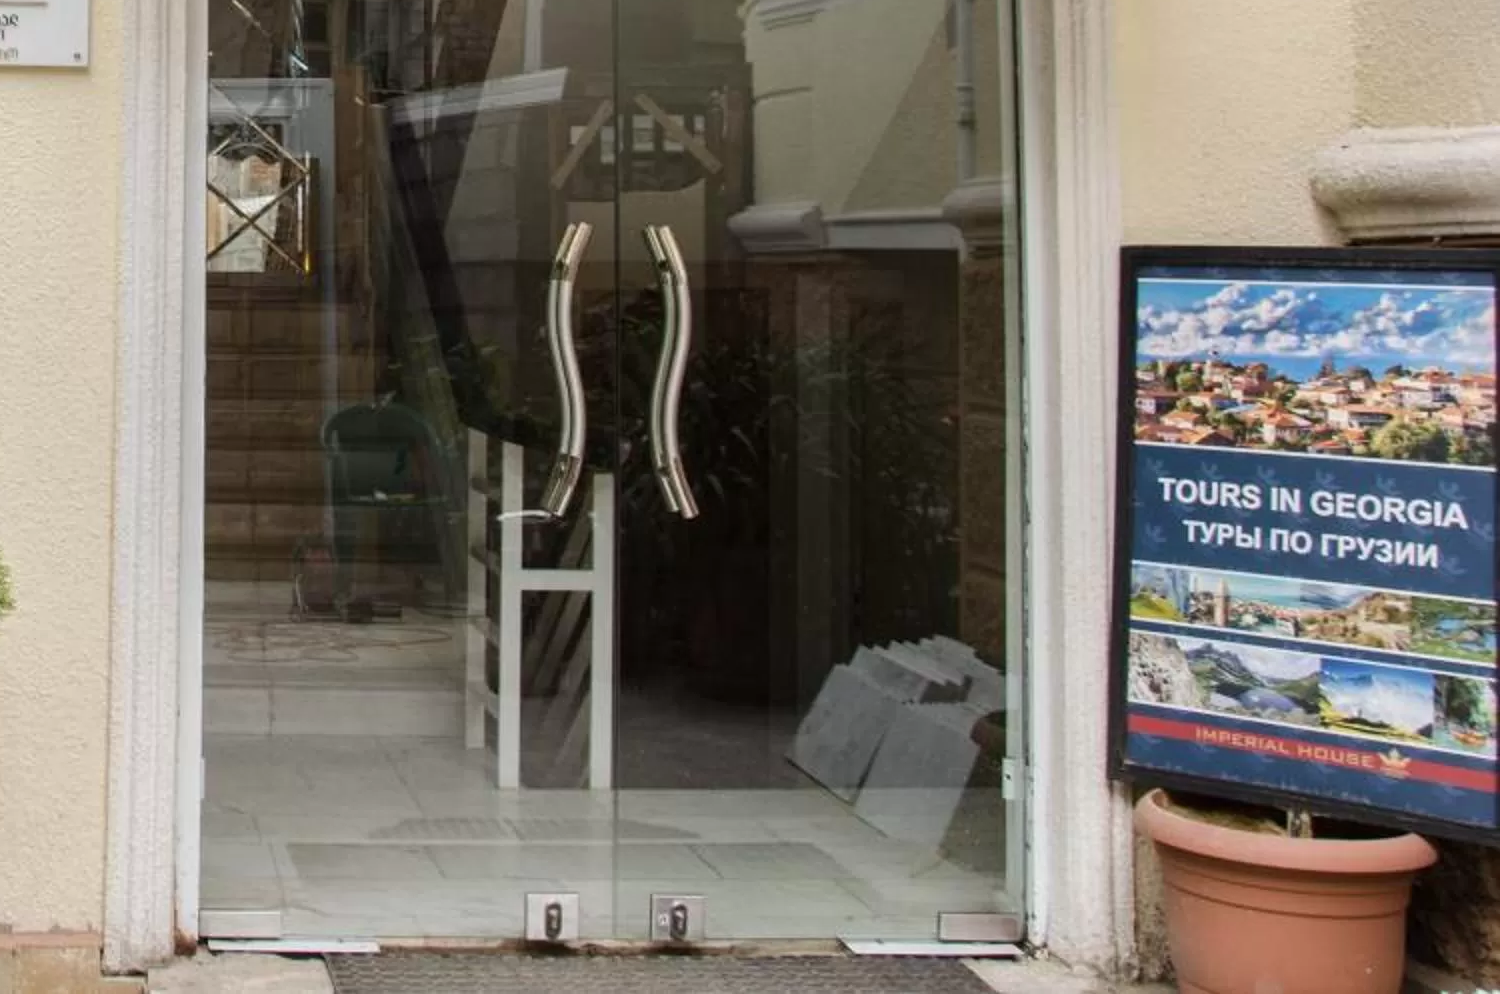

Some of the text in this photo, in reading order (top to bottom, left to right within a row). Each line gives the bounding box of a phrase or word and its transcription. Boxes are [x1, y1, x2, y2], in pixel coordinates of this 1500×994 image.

[1158, 477, 1470, 529] TOURS IN GEORGIA
[1182, 519, 1440, 568] ТУРЫ ПО ГРУЗИИ
[1195, 726, 1375, 769] IMPERIAL HOUSE
